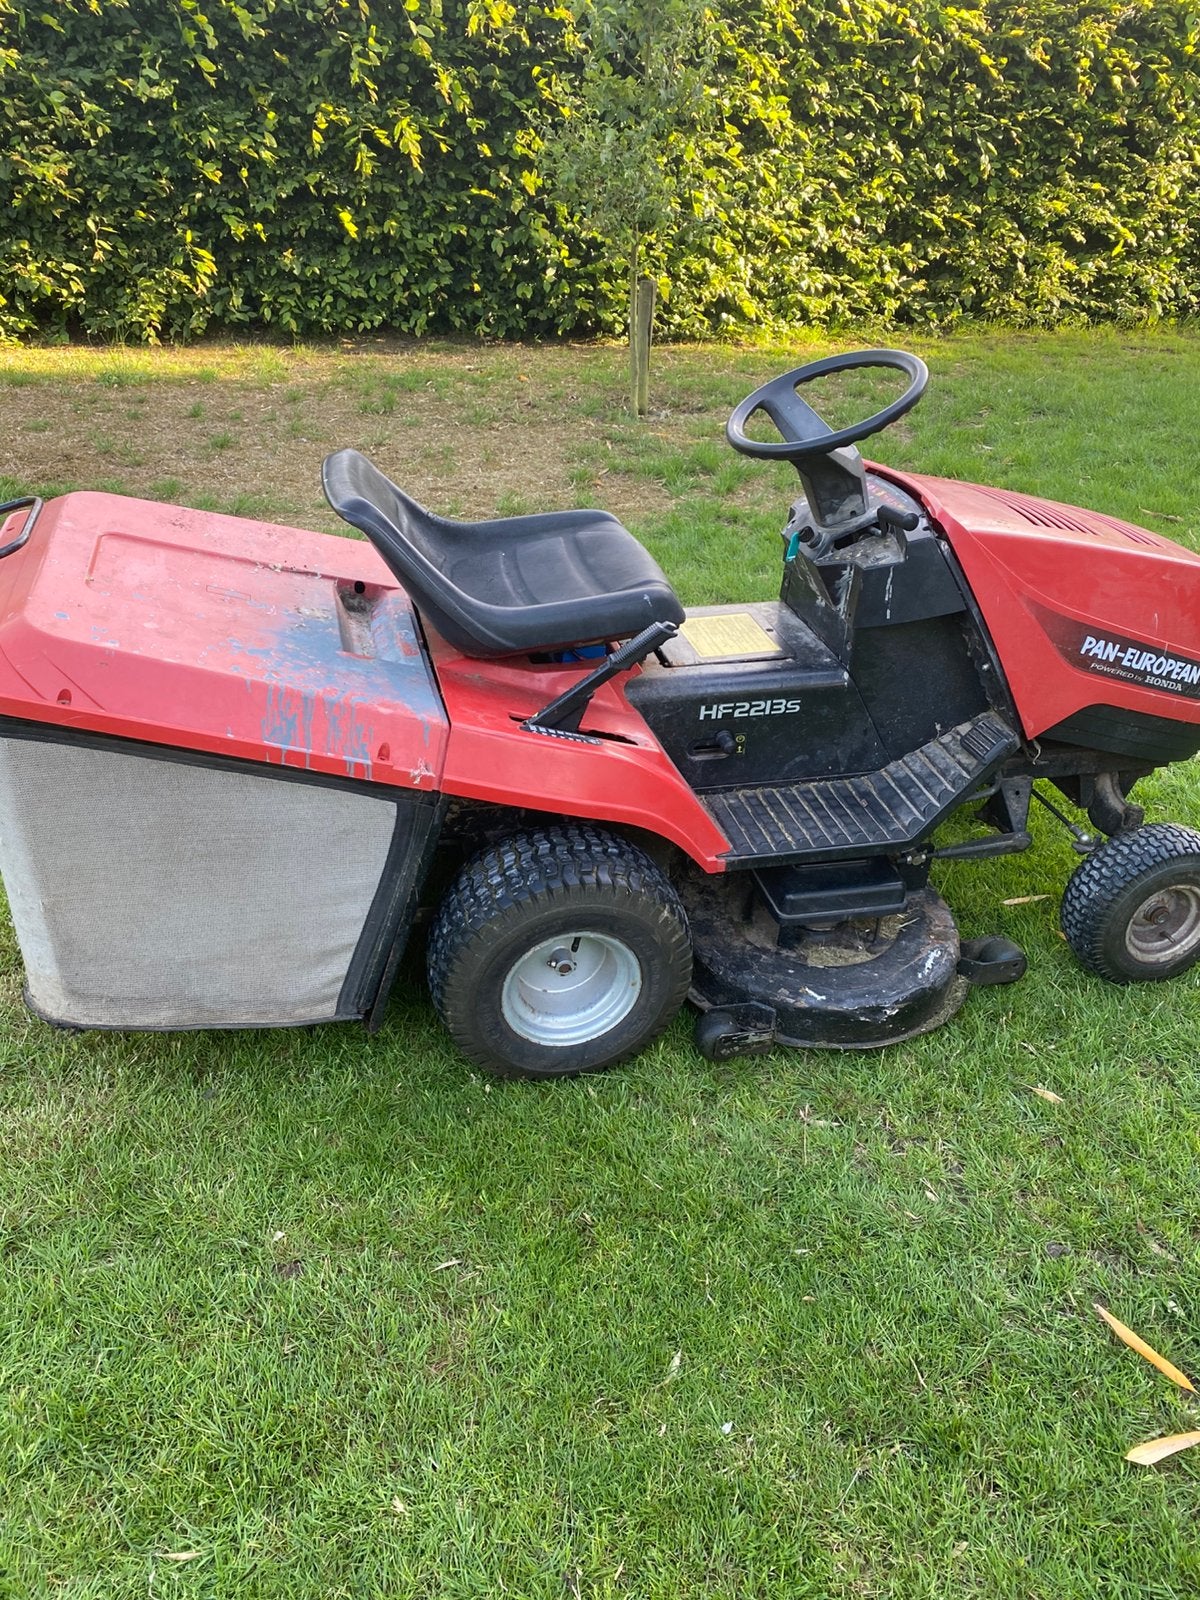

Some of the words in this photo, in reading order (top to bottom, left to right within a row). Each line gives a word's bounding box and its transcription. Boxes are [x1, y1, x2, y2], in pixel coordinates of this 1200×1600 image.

[1080, 635, 1200, 684] PAN-EUROPEAN
[1090, 662, 1134, 678] POWERED
[1145, 675, 1182, 691] HONDA
